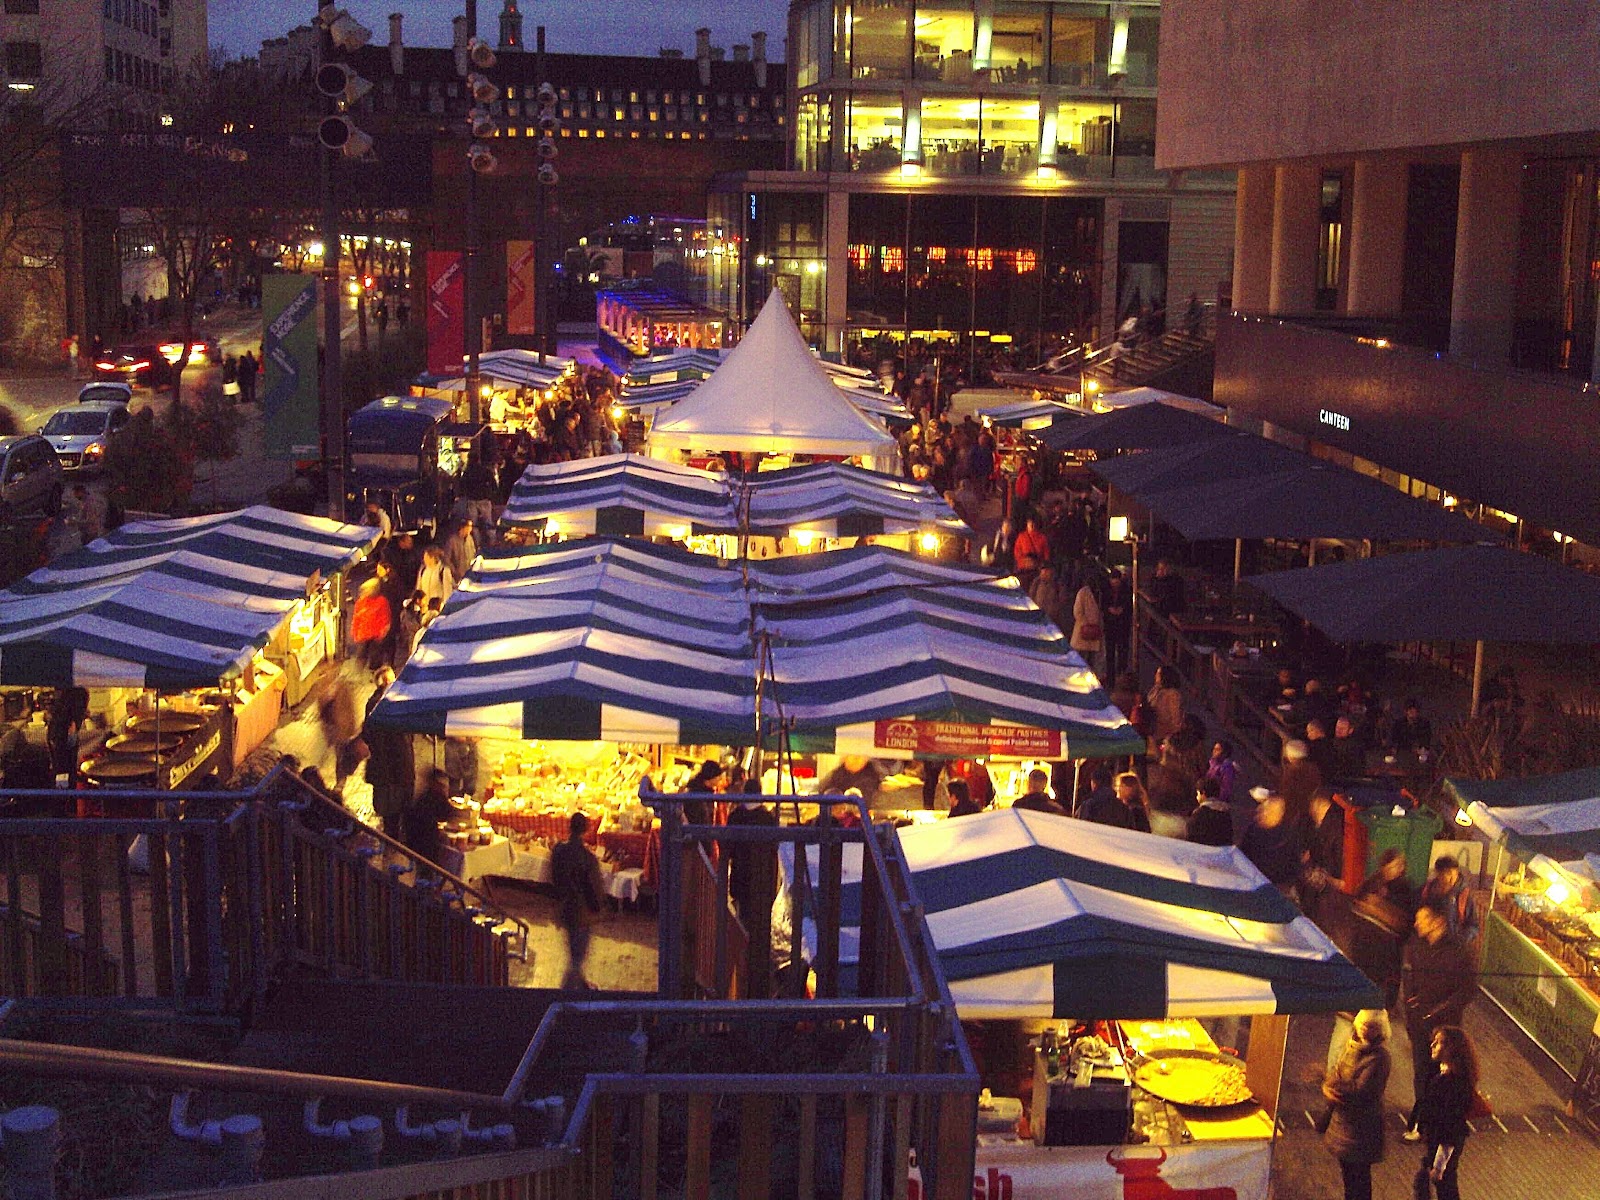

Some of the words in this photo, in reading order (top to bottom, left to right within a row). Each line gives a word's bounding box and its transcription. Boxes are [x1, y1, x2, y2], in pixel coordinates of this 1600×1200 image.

[1319, 408, 1350, 431] CANTEEN
[935, 724, 979, 735] TRADITIONAL
[885, 737, 918, 749] LONDON
